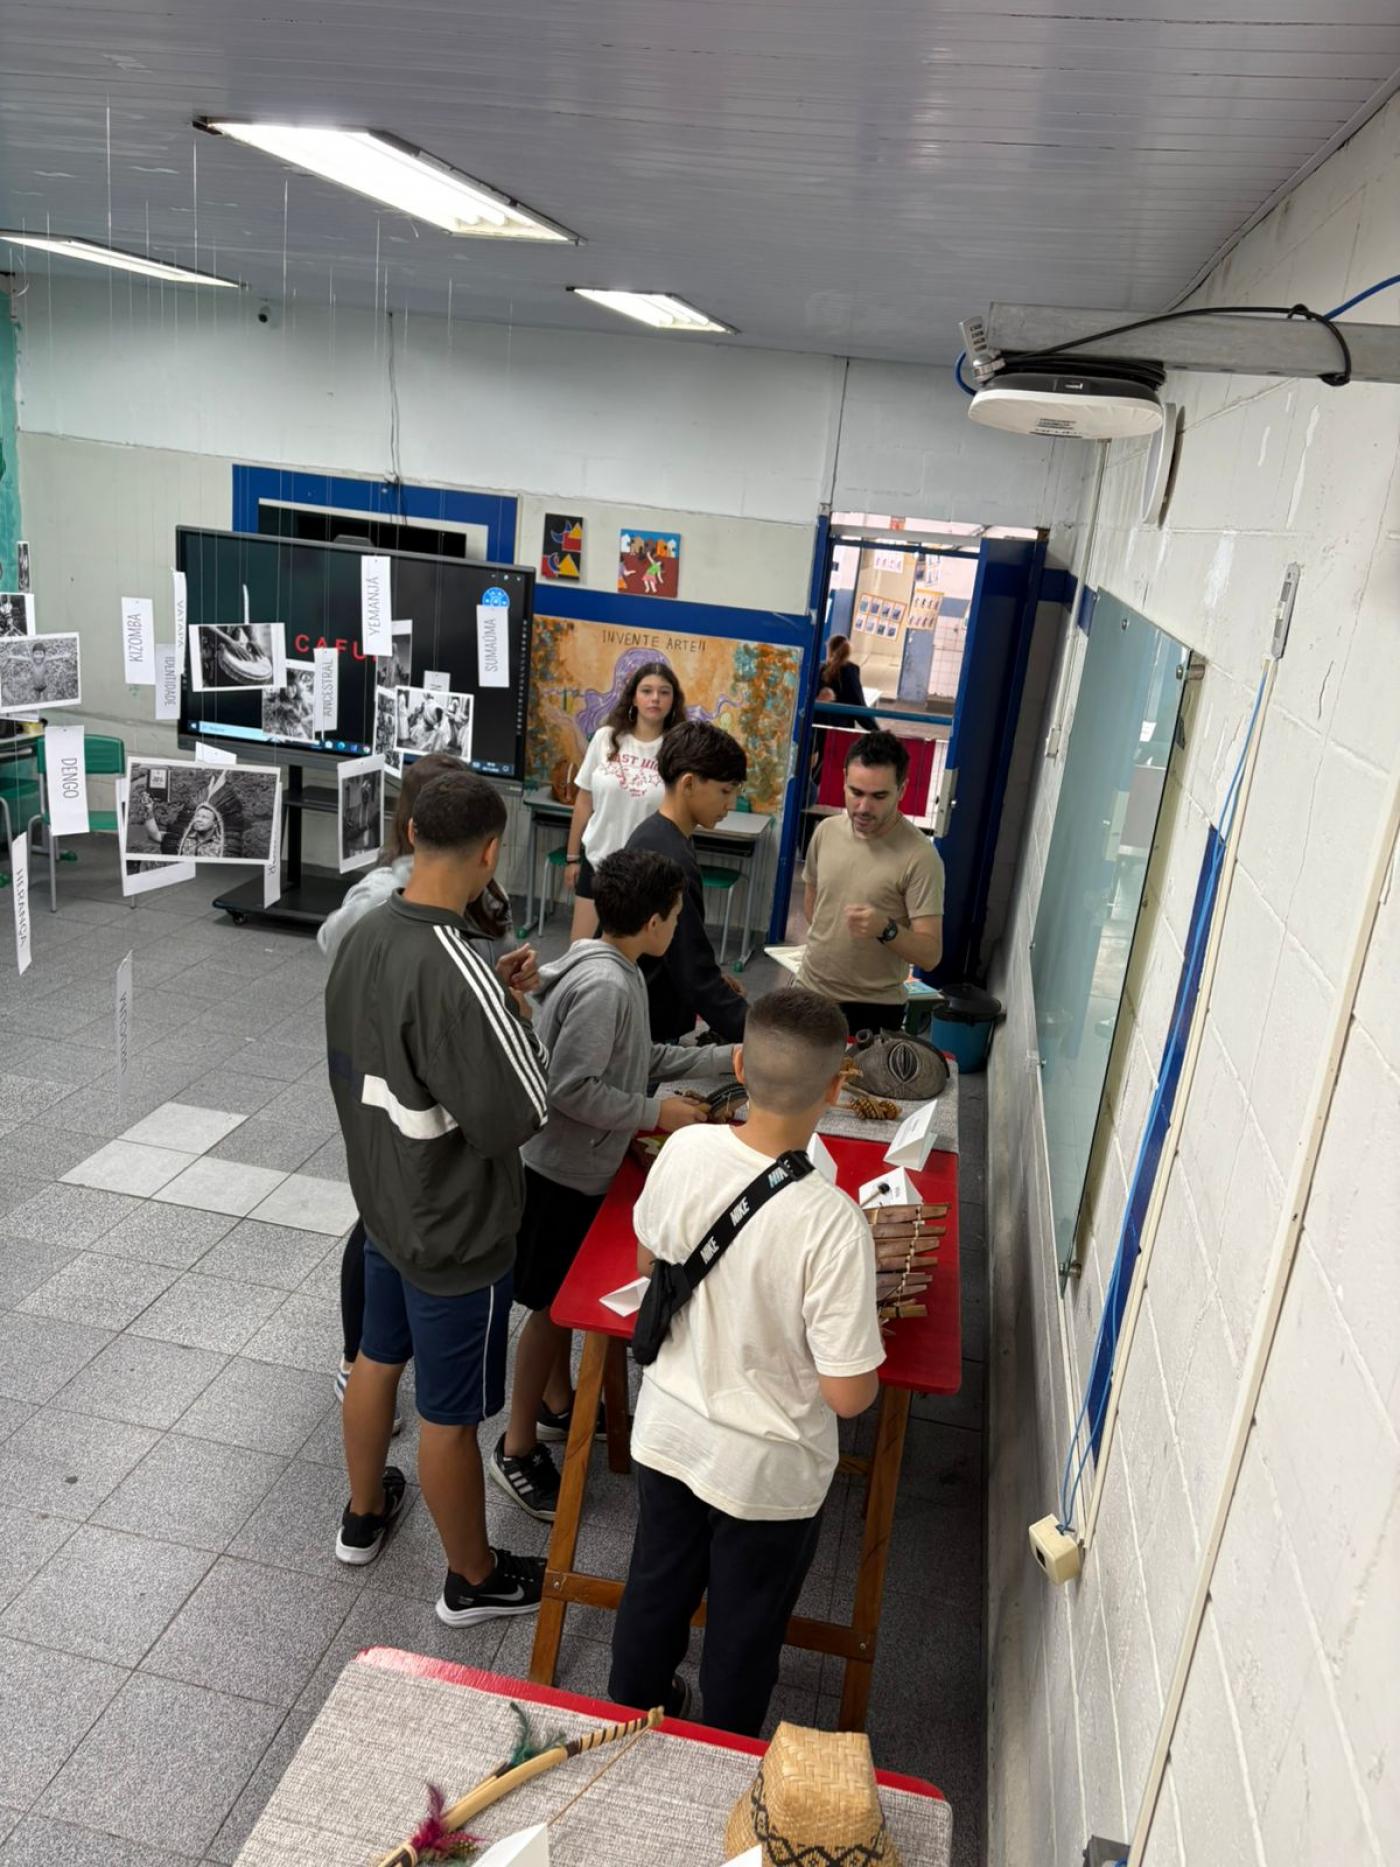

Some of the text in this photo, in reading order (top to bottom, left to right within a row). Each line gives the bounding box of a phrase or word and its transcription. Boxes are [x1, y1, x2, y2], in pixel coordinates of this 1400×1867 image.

[366, 576, 381, 636] YEMANJÁ
[127, 613, 143, 662] KIZOMBA
[484, 618, 498, 673] SUMAÚMA
[602, 629, 660, 648] INVENTE
[164, 656, 177, 706] IDENTIDADE
[320, 659, 334, 717] ANCESTRAL
[61, 758, 80, 799] DENGO
[729, 1196, 750, 1227] NIKE
[700, 1236, 719, 1265] NIKE
